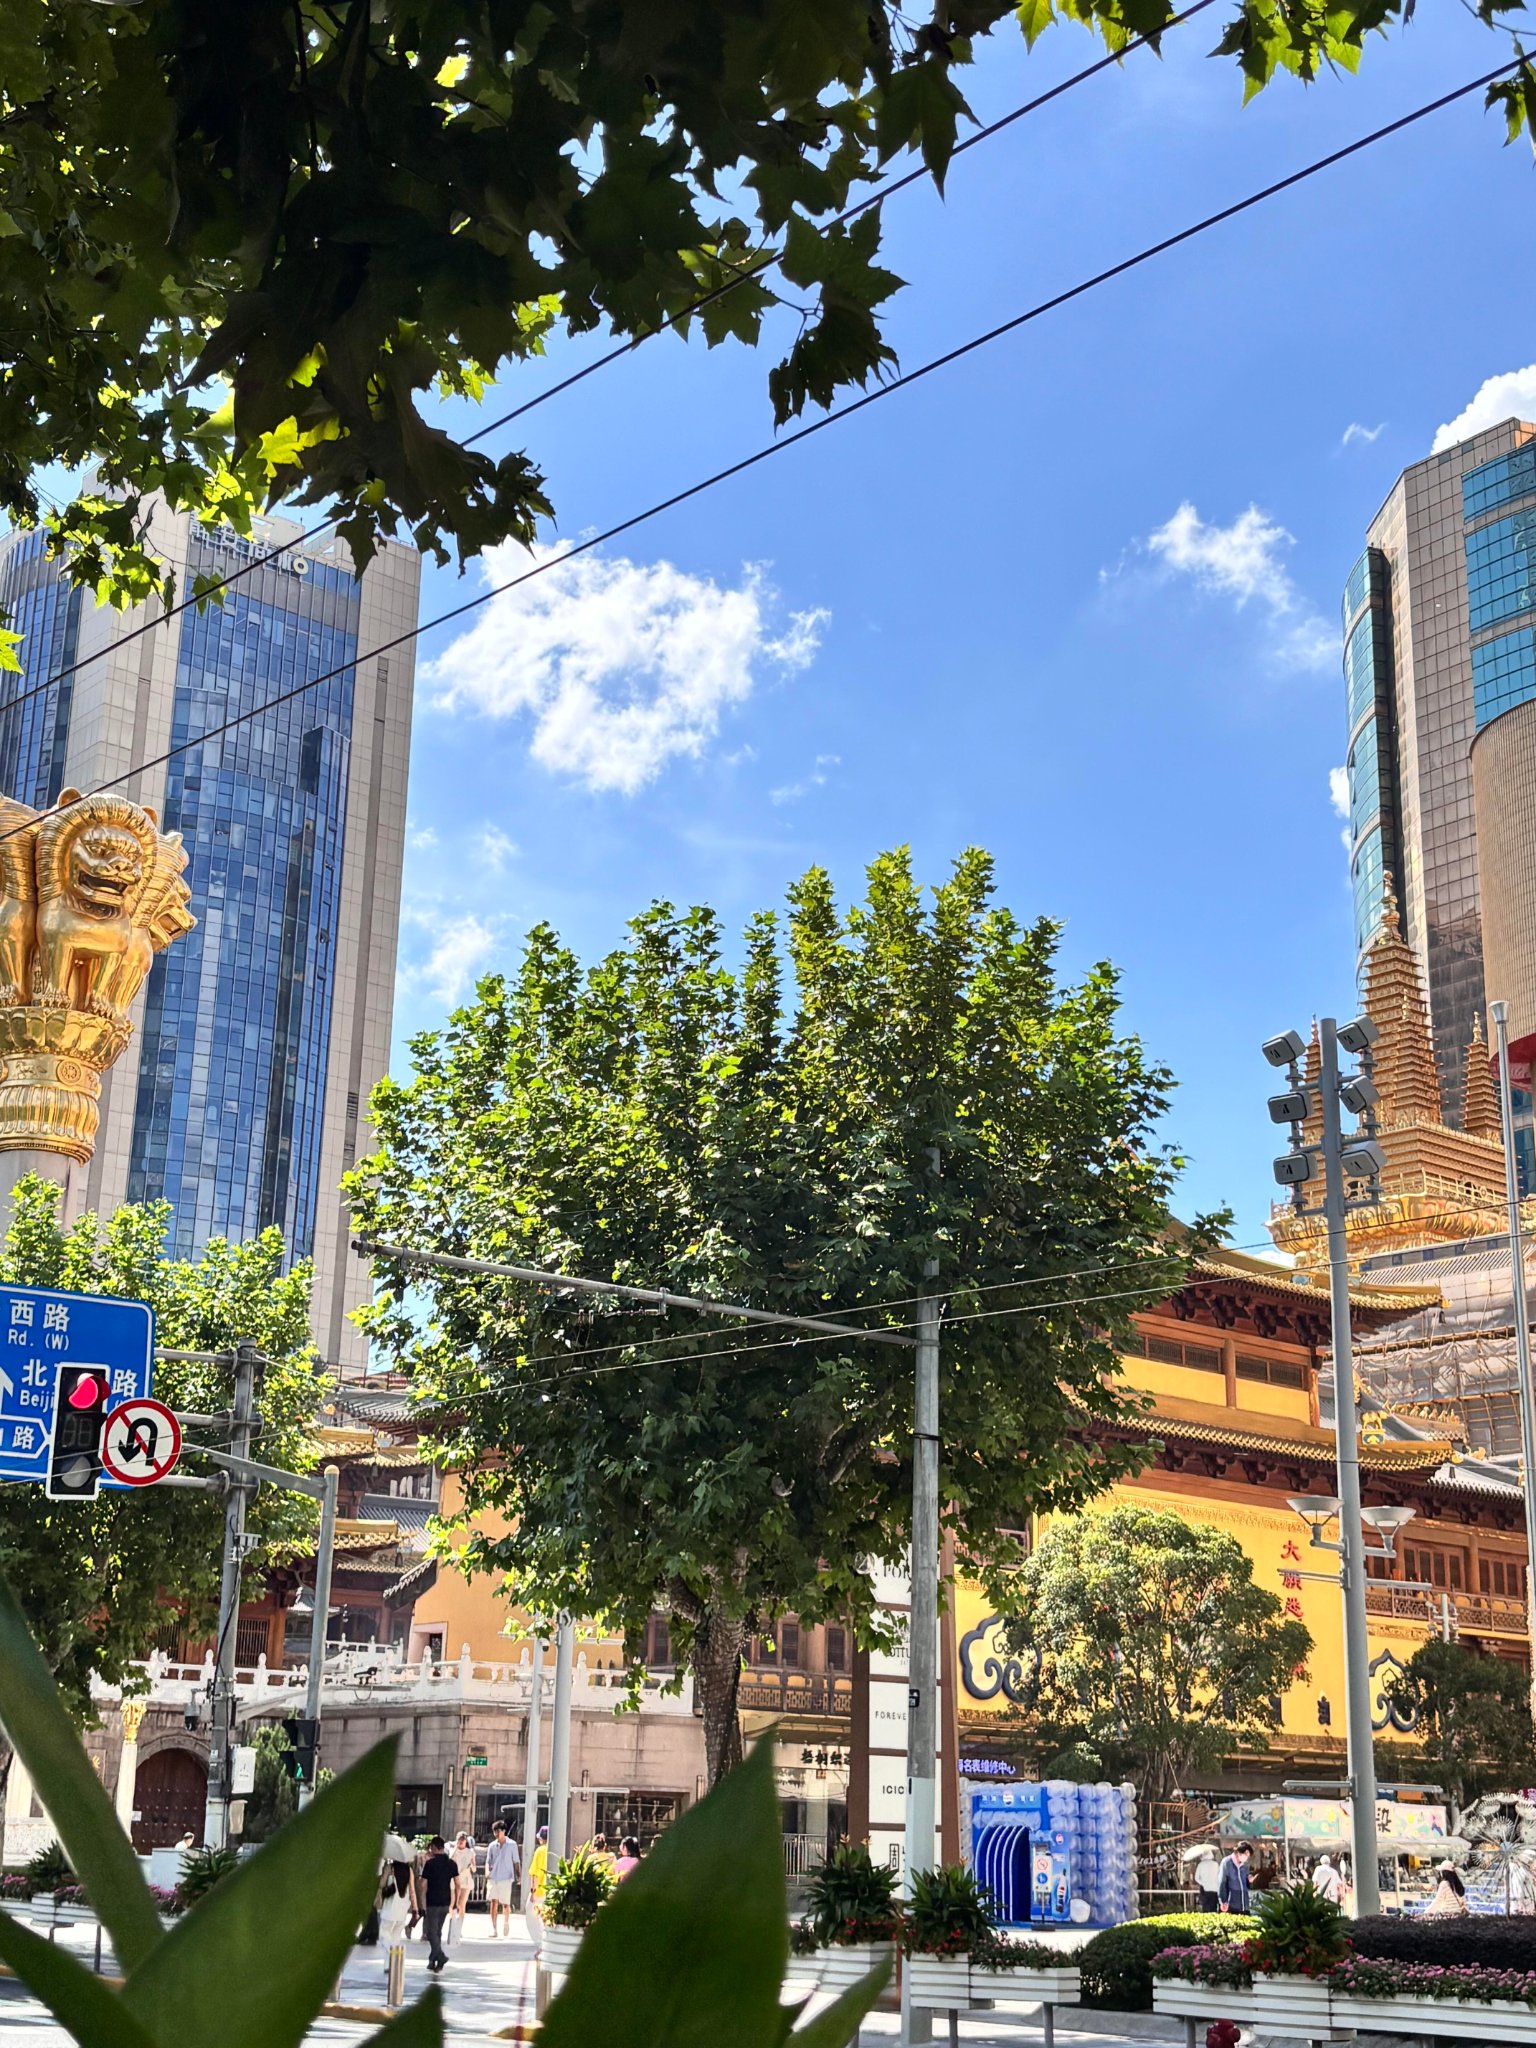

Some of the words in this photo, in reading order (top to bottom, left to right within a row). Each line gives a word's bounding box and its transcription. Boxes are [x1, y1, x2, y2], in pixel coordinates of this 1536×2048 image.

[9, 1298, 71, 1332] 西路
[8, 1328, 34, 1347] Rd.
[45, 1333, 70, 1351] (W)
[882, 1784, 905, 1795] ICIC
